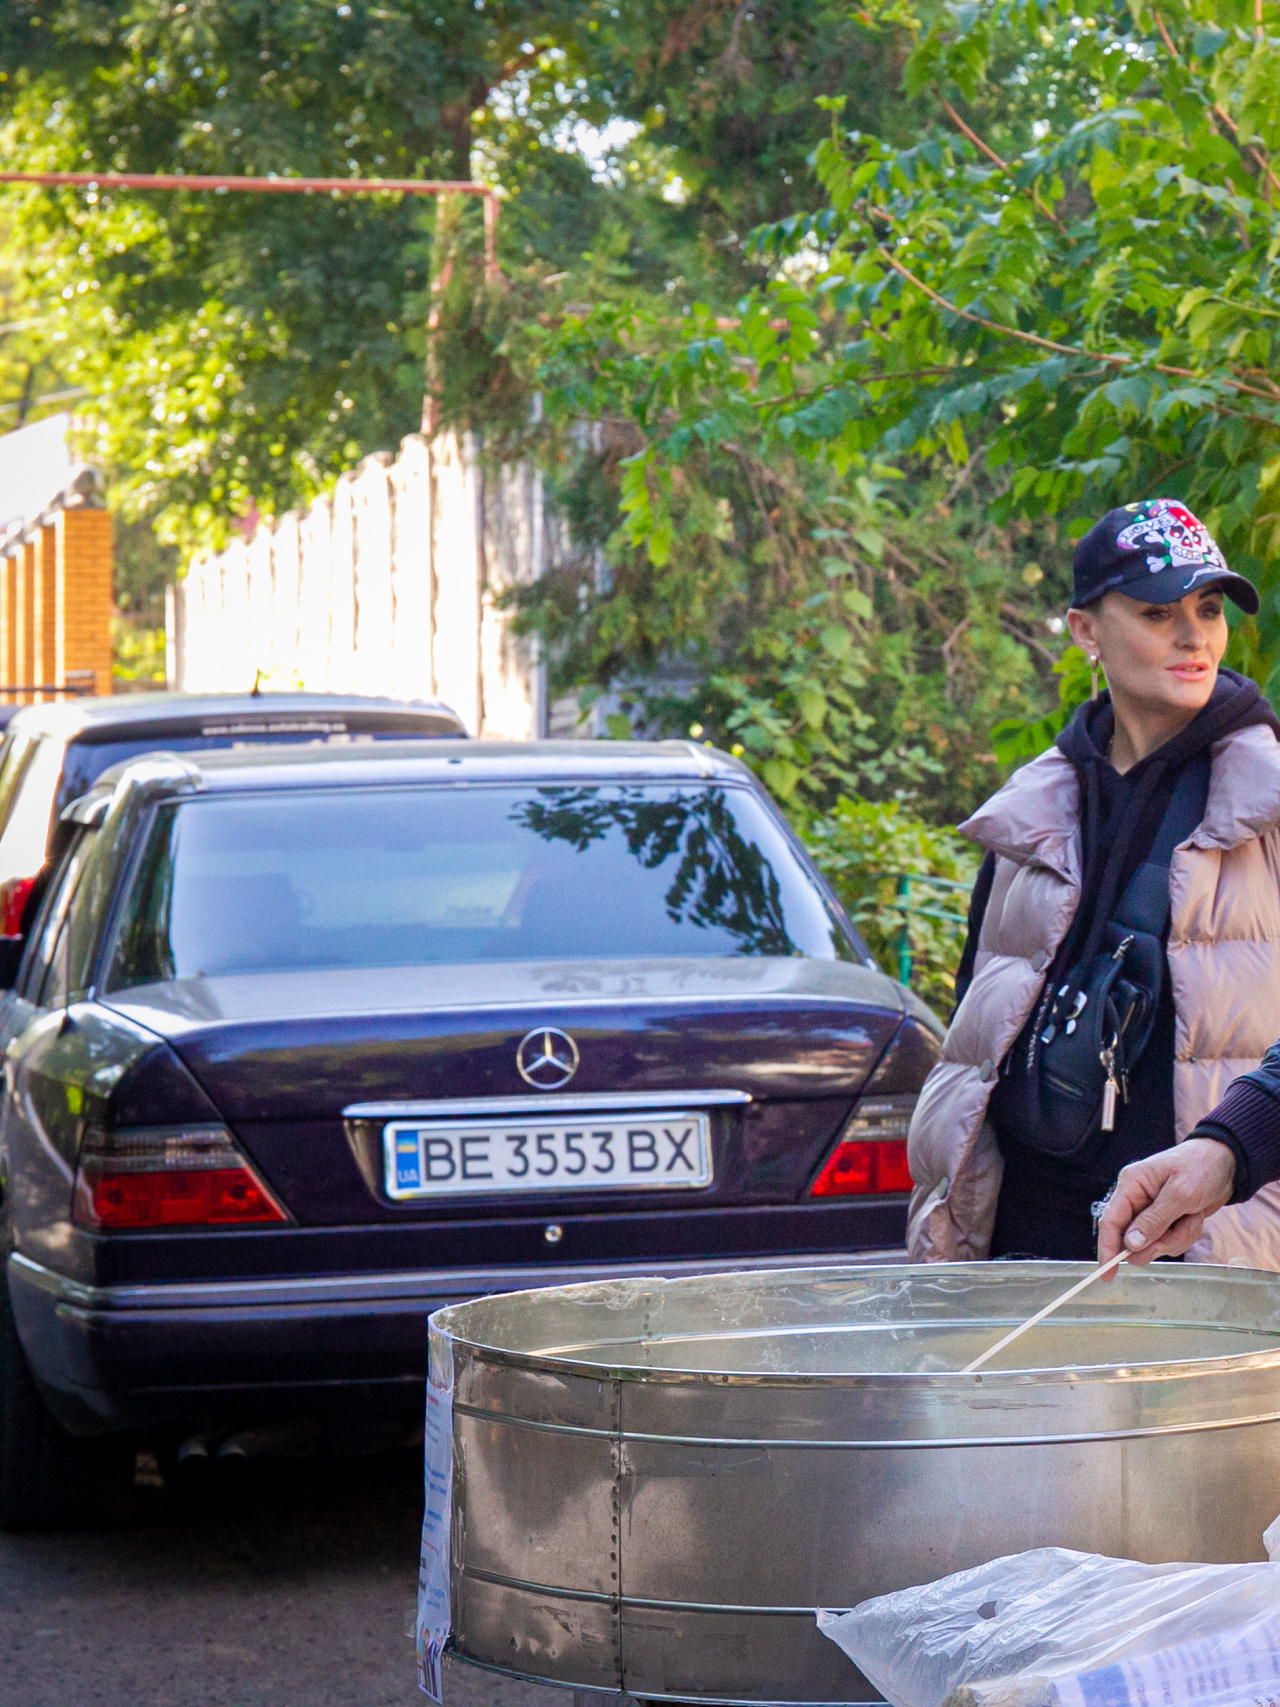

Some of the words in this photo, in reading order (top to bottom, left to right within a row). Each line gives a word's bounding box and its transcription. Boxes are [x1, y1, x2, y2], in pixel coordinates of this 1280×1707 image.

[423, 1136, 494, 1182] BE
[504, 1131, 616, 1177] 3553
[627, 1128, 696, 1173] BX
[398, 1168, 420, 1184] UA
